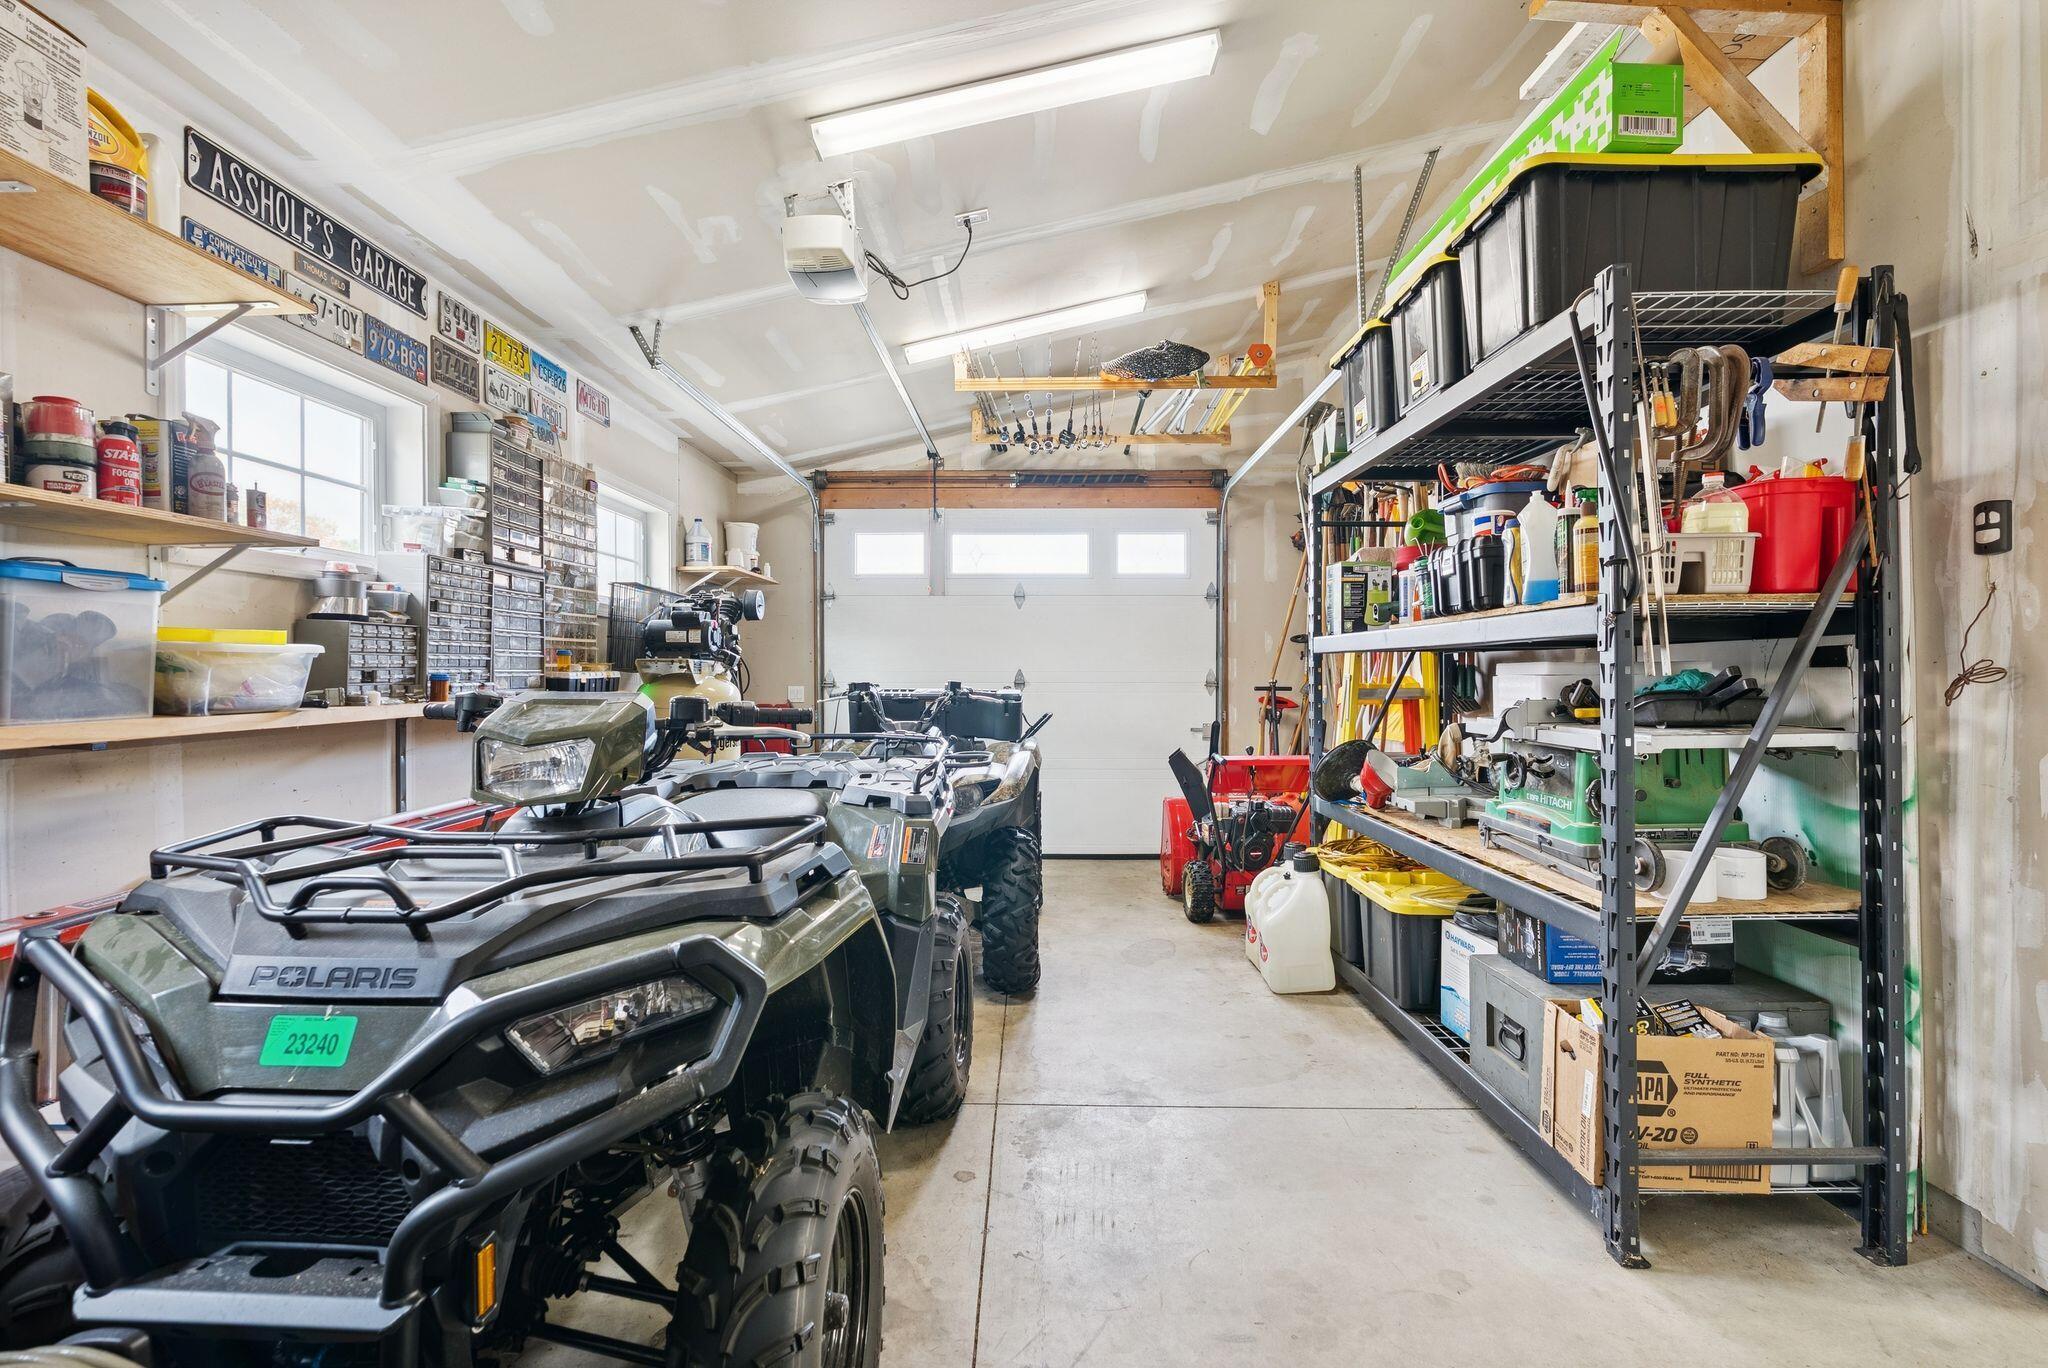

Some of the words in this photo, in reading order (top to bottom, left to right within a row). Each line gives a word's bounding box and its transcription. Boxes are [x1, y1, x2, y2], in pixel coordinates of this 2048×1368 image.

[88, 129, 111, 145] NZOIL
[209, 151, 334, 260] ASSHOLE'S
[350, 237, 417, 309] GARAGE
[208, 229, 263, 270] CONNECTICUT
[1540, 793, 1572, 811] HITACHI
[1450, 933, 1476, 953] HAYWARD
[248, 965, 418, 990] POLARIS
[284, 1033, 339, 1055] 23240
[1684, 1072, 1710, 1080] FULL
[1684, 1079, 1742, 1087] SYNTHETIC
[1637, 1076, 1664, 1101] APA
